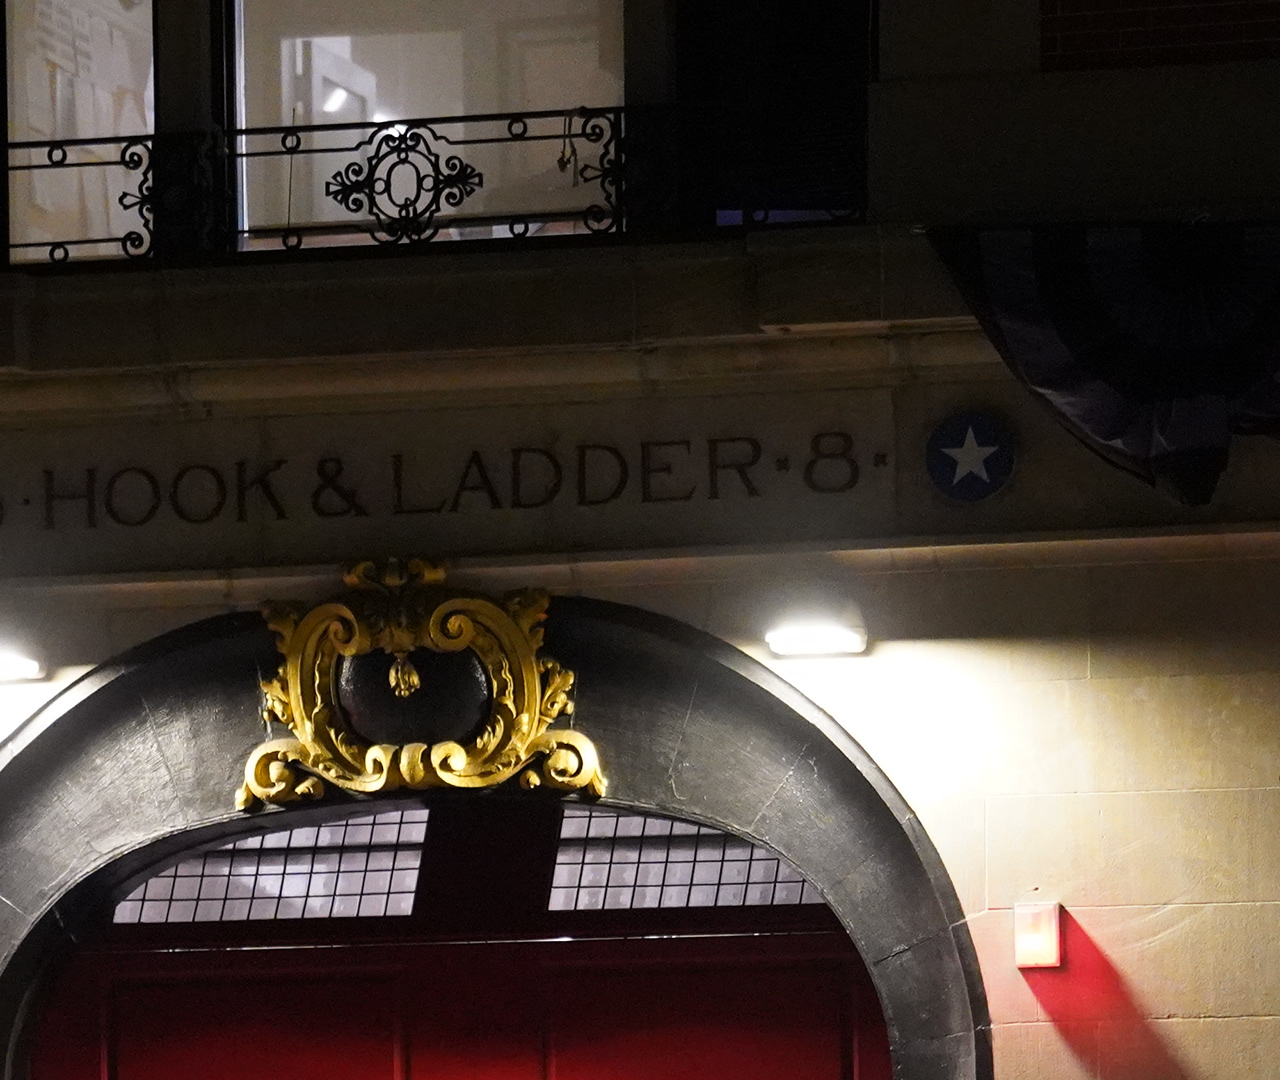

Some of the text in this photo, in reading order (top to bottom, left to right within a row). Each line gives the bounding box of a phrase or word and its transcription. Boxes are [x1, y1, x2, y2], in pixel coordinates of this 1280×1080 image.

[42, 459, 289, 529] HOOK
[311, 457, 369, 517] &
[391, 436, 762, 515] LADDER
[803, 431, 861, 494] 8
